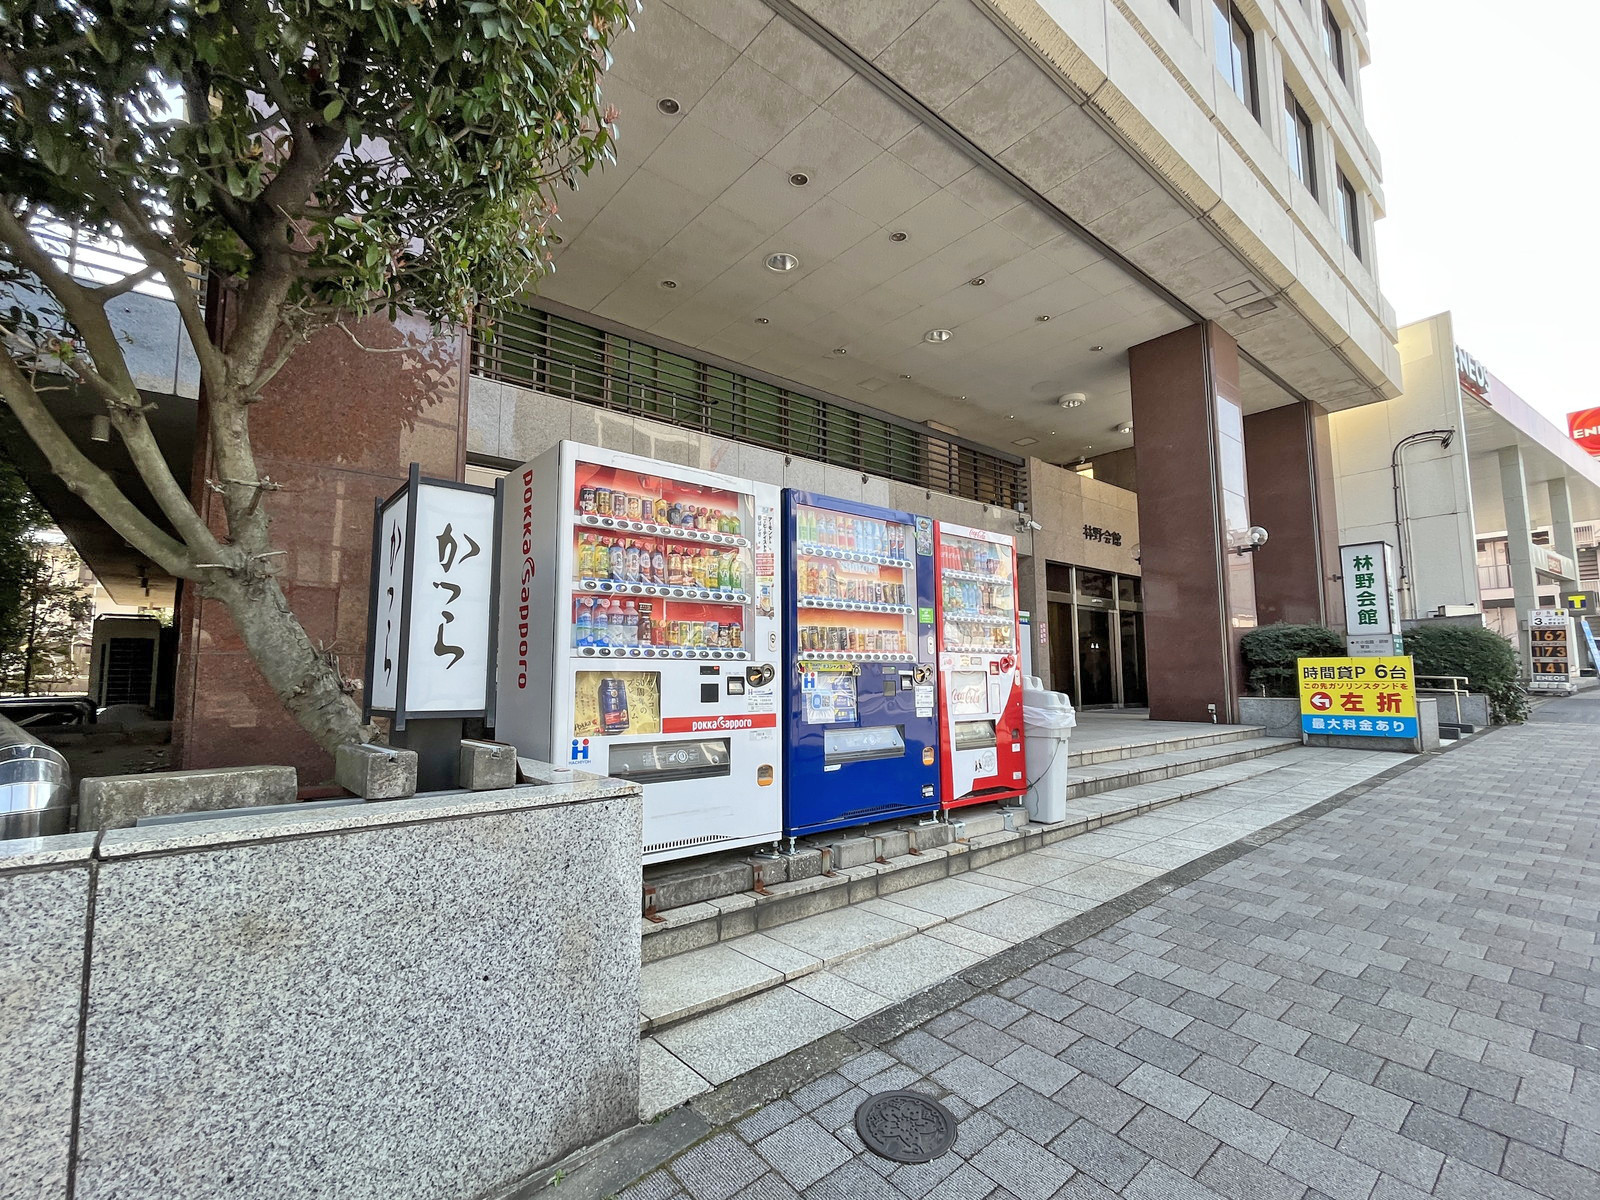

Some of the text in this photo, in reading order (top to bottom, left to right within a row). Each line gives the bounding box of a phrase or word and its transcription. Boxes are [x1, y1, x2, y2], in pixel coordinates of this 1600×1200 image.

[1573, 425, 1600, 439] EN
[432, 522, 481, 670] かつら
[1353, 554, 1379, 626] 林野会館
[1534, 631, 1566, 641] 162
[1535, 647, 1566, 657] 173
[1536, 663, 1565, 673] 141
[1303, 682, 1408, 690] この先ガソリンスタンドを
[1312, 718, 1405, 732] 最大料金あり
